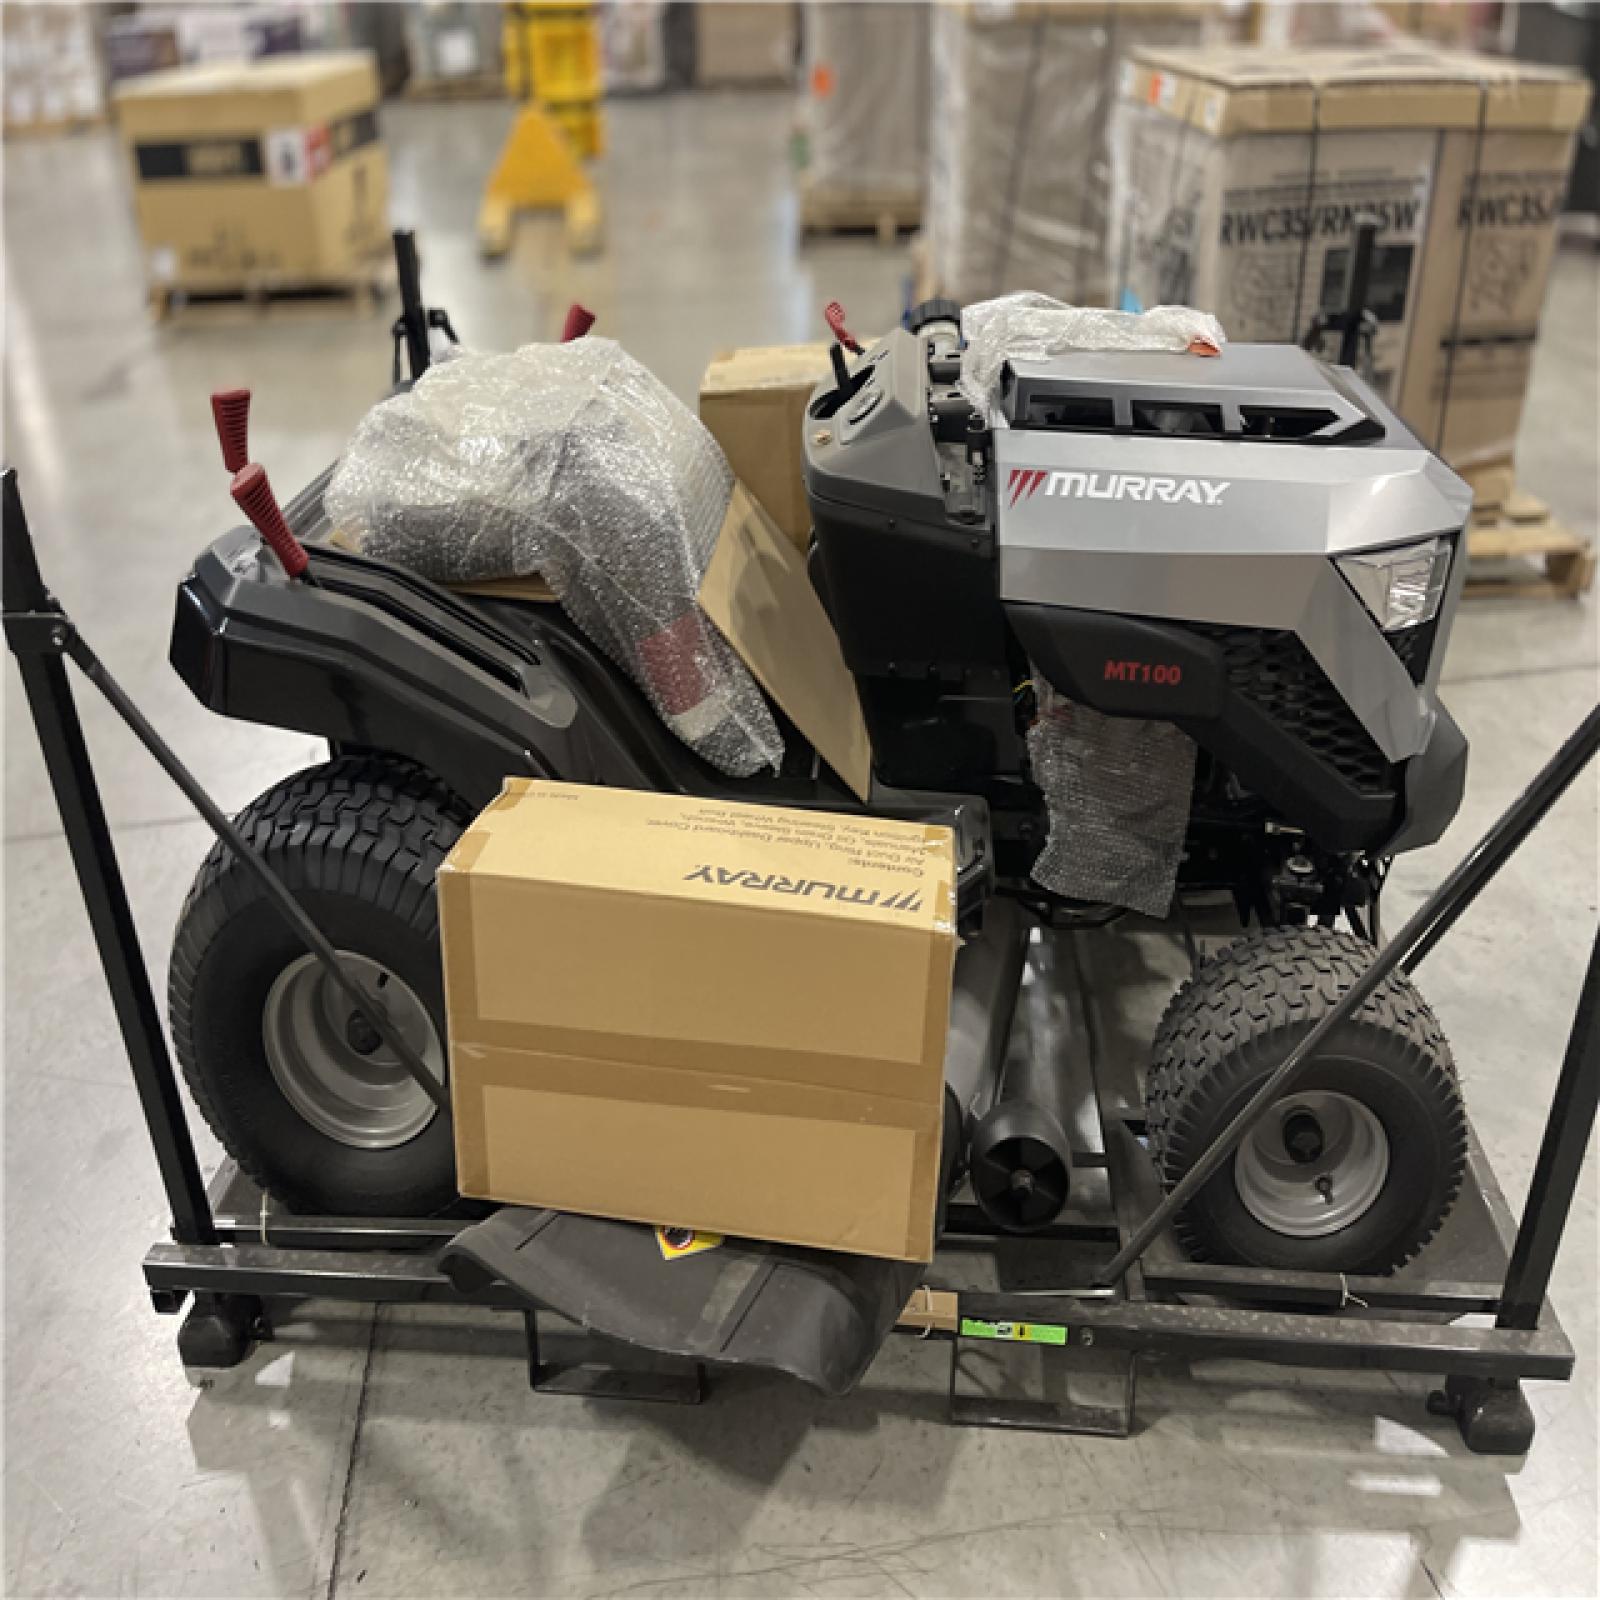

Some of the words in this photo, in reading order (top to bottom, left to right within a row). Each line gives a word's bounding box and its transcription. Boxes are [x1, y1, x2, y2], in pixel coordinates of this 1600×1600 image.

[1045, 471, 1231, 506] MURRAY
[1104, 660, 1181, 685] MT100
[682, 865, 881, 906] MURRAY
